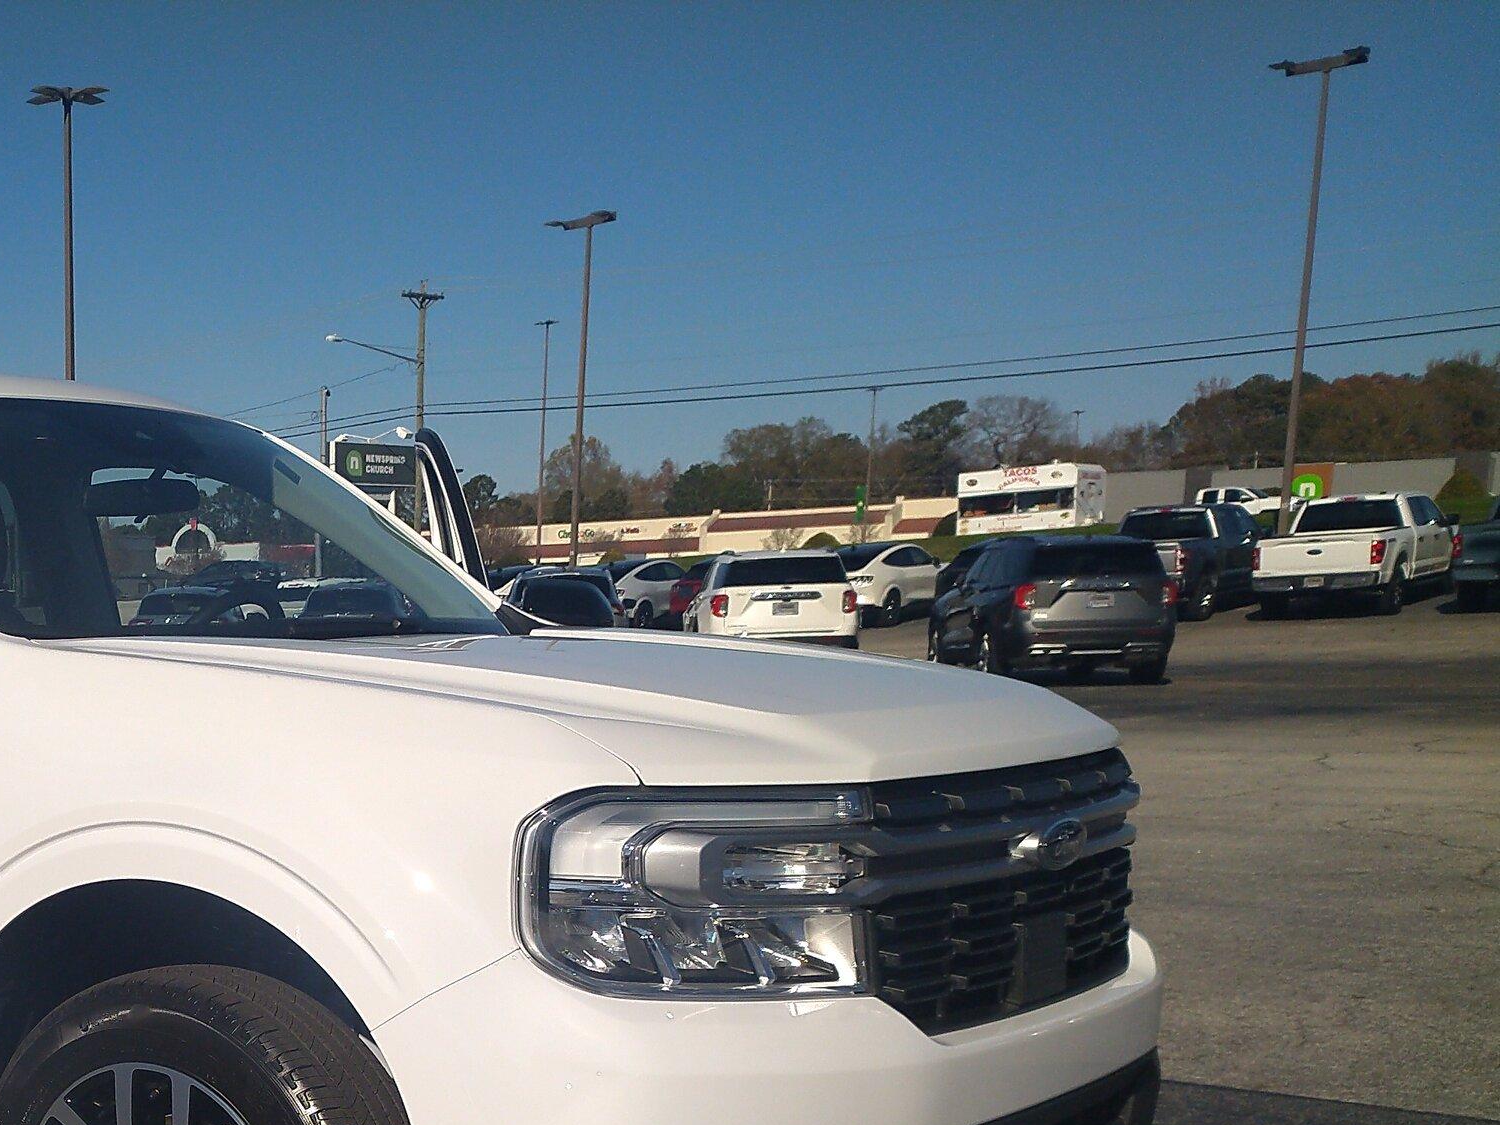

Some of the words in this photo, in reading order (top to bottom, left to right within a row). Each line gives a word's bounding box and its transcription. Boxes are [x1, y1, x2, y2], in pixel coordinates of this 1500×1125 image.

[365, 454, 406, 464] NEWSPRING
[365, 465, 394, 474] CHURCH
[1003, 467, 1037, 477] TACOS
